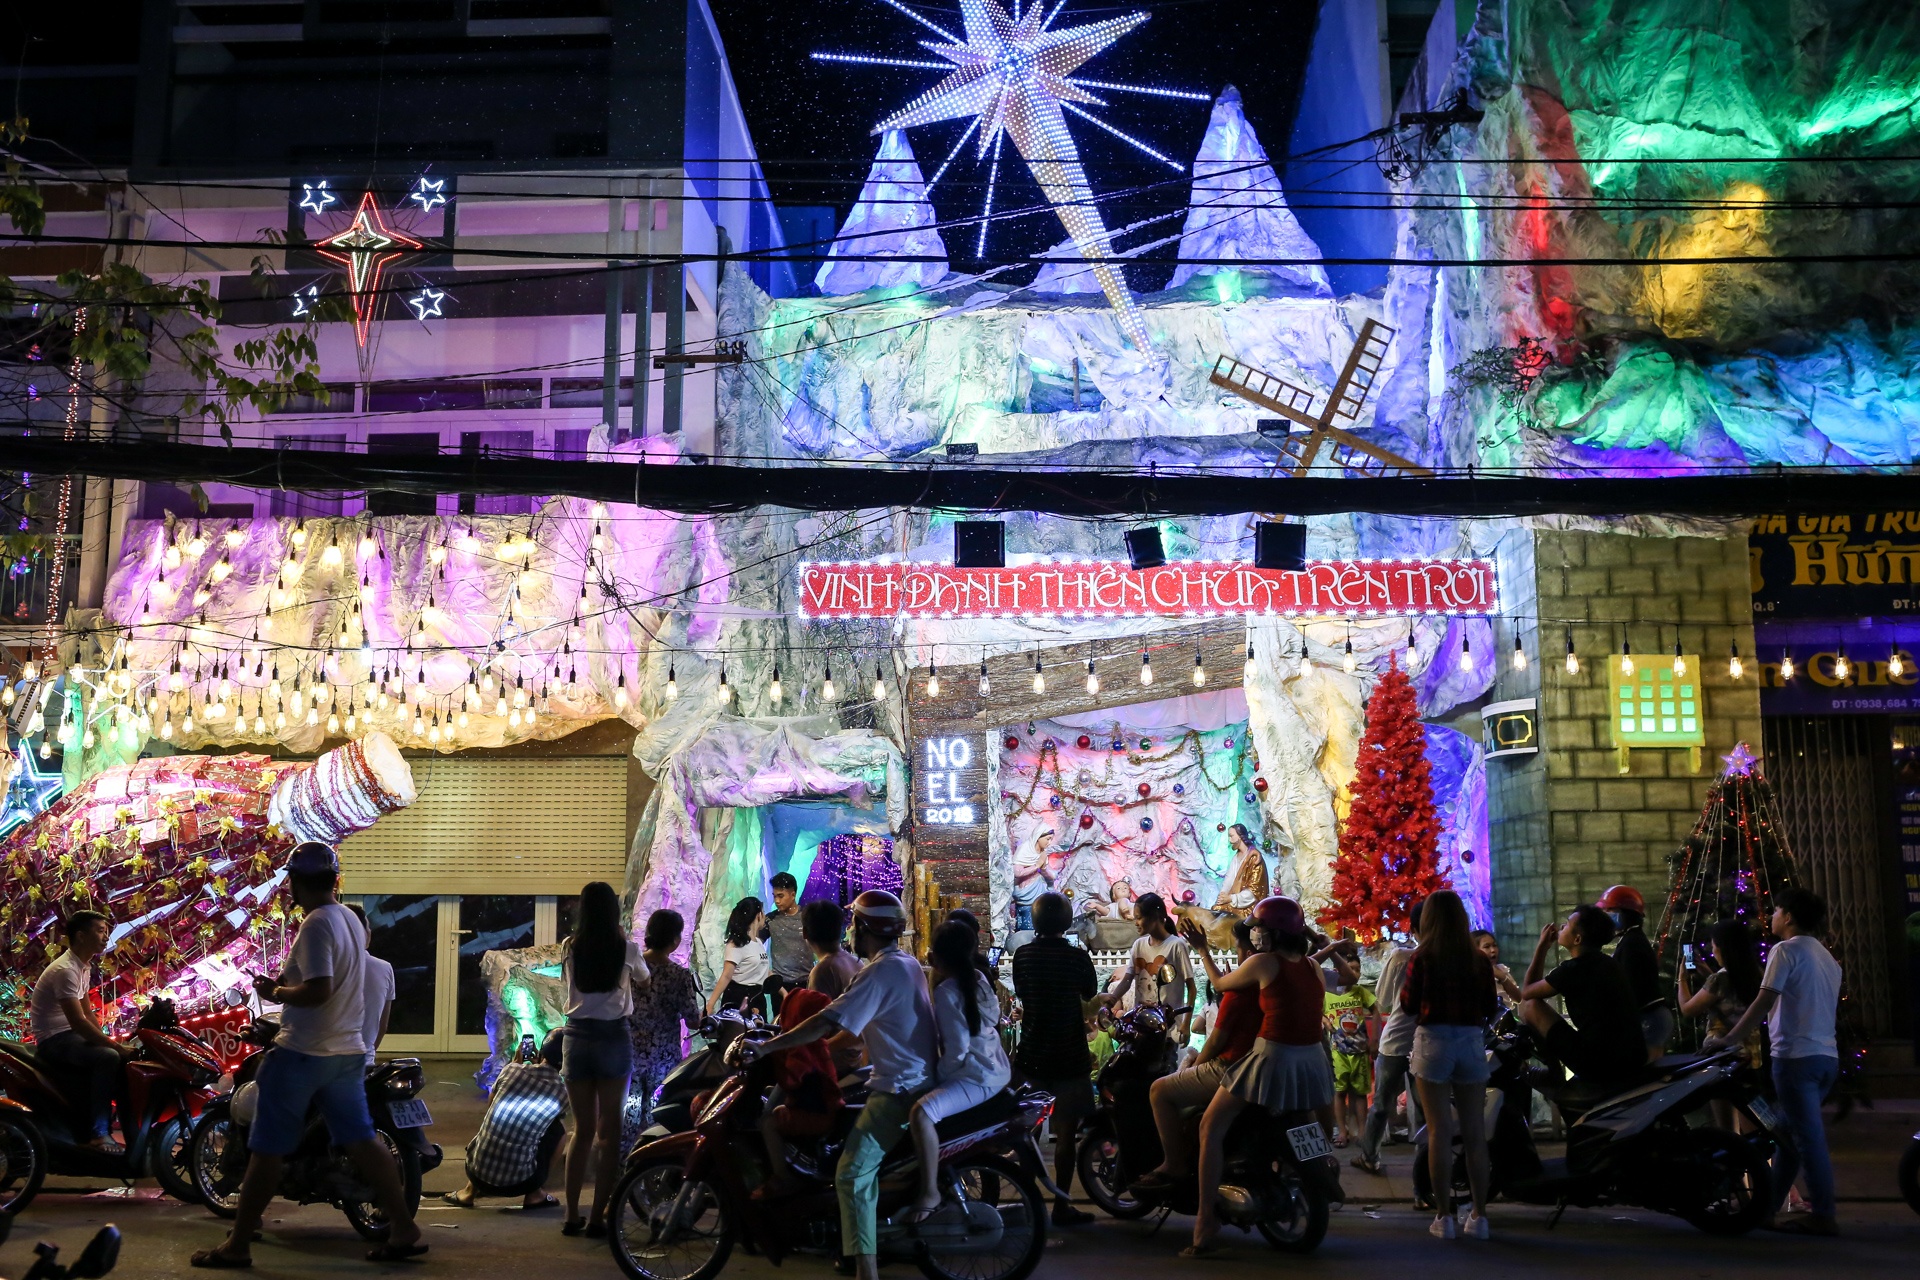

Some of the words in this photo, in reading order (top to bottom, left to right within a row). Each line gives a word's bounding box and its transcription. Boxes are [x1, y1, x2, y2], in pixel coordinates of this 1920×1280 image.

[1798, 514, 1852, 534] GIA
[804, 569, 899, 608] VINH
[1029, 564, 1146, 608] THIÊN
[1151, 563, 1280, 611] CHÚA
[1281, 563, 1393, 607] TRÊN
